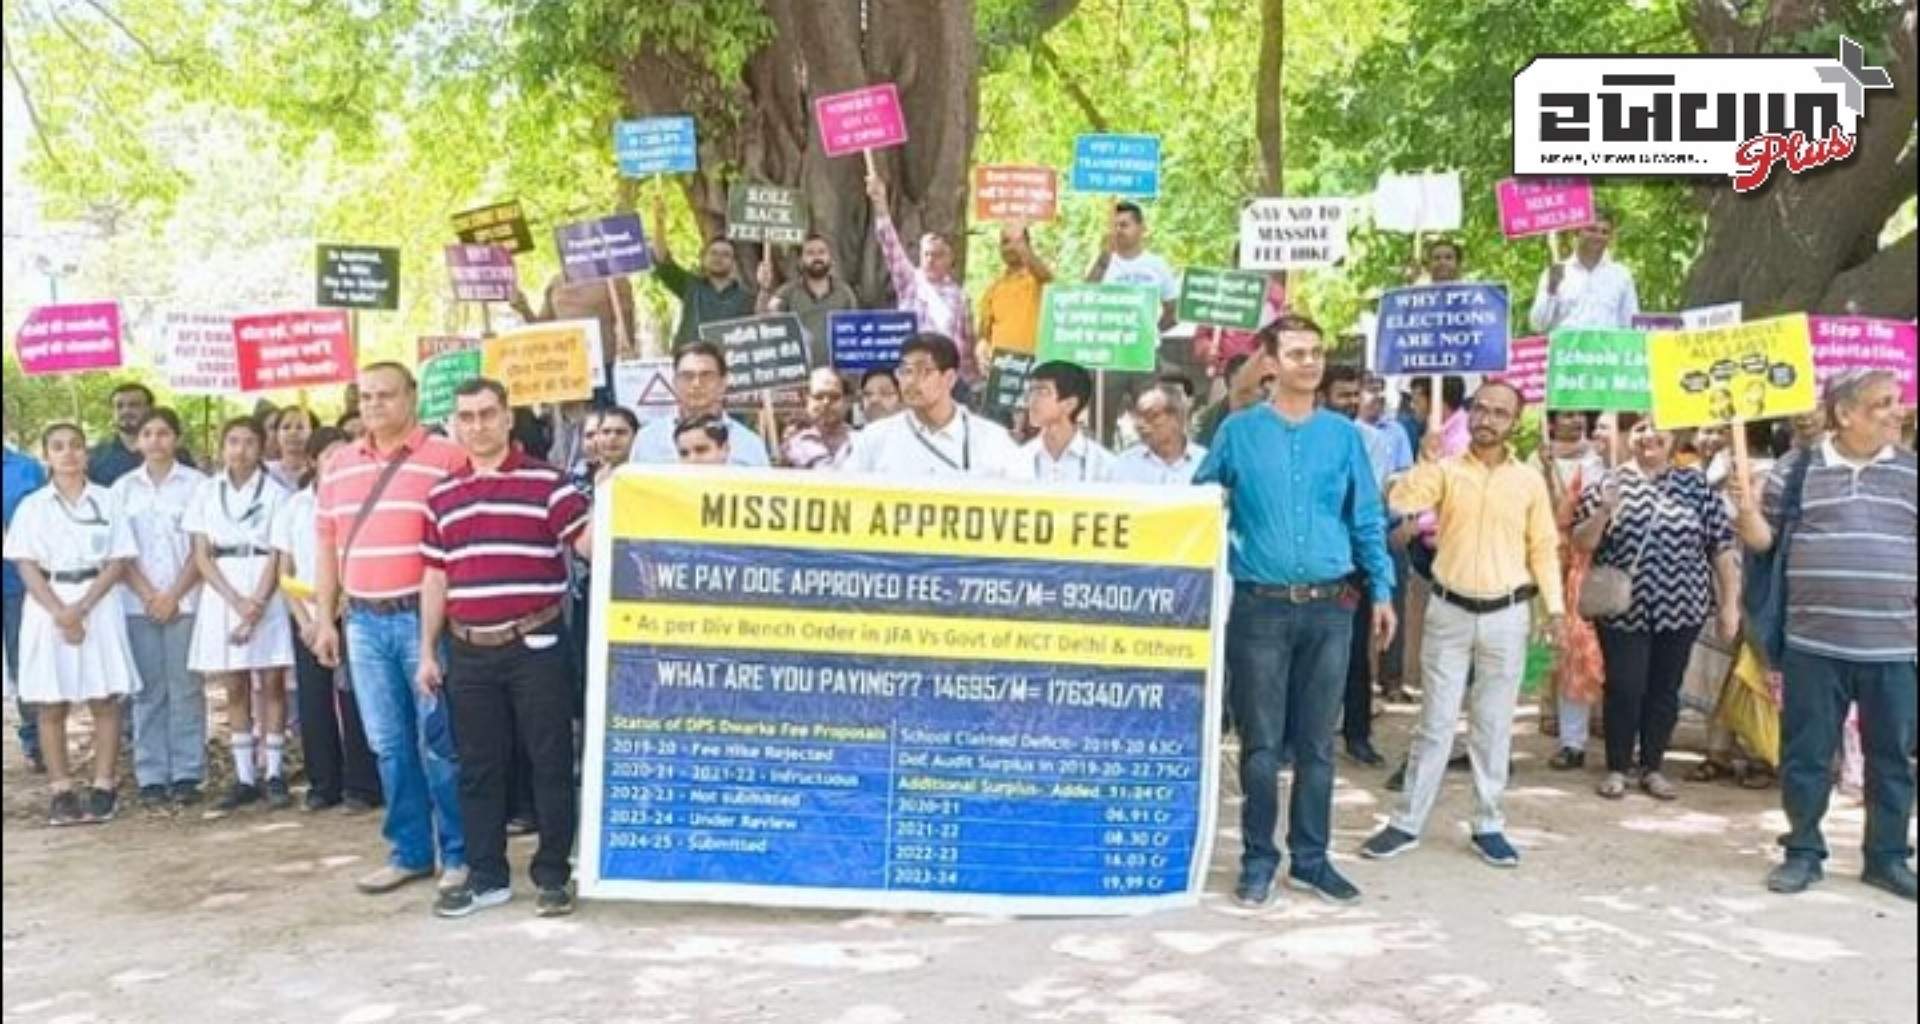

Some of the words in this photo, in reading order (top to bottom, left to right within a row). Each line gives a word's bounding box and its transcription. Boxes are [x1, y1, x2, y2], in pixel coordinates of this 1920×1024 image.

[747, 187, 792, 205] ROLL
[745, 206, 792, 223] BACK
[1250, 206, 1279, 220] SAY
[1288, 206, 1313, 220] NO
[1320, 205, 1340, 220] TO
[728, 223, 761, 240] FEE
[1258, 226, 1329, 241] MASSIVE
[1255, 246, 1282, 261] FEE
[1290, 246, 1328, 261] HIKE
[1394, 292, 1440, 308] WHY
[1446, 289, 1486, 305] PTA
[1385, 309, 1497, 330] ELECTIONS
[1817, 321, 1861, 339] Stop
[1866, 319, 1895, 339] the
[1396, 332, 1435, 348] ARE
[1439, 329, 1484, 346] NOT
[1402, 351, 1457, 369] HELD
[1463, 351, 1474, 367] ?
[1555, 349, 1619, 366] Schools
[1554, 373, 1591, 391] DoE
[701, 492, 851, 535] MISSION
[868, 500, 1054, 546] APPROVED
[1071, 511, 1131, 549] FEE
[657, 564, 689, 591] WE
[695, 565, 737, 593] PAY
[743, 567, 784, 595] DOE
[790, 569, 900, 600] APPROVED
[906, 575, 953, 601] FEE-
[958, 577, 1057, 607] 7785/M=
[1062, 582, 1175, 614] 93400/YR
[637, 614, 659, 633] As
[665, 618, 696, 639] per
[702, 617, 731, 636] Div
[738, 618, 796, 637] Bench
[802, 621, 854, 641] Order
[860, 623, 877, 641] in
[884, 623, 913, 645] JFA
[918, 627, 940, 645] Vs
[944, 628, 985, 648] Govt
[992, 629, 1013, 648] of
[1017, 630, 1054, 651] NCT
[1058, 632, 1108, 653] Delhi
[1114, 637, 1127, 655] &
[1133, 637, 1196, 659] Others
[657, 660, 718, 687] WHAT
[731, 662, 767, 690] ARE
[771, 665, 813, 692] YOU
[819, 668, 921, 698] PAYING??
[1047, 679, 1165, 711] 176340/YR
[610, 715, 661, 732] Status
[667, 717, 682, 732] of
[685, 718, 716, 734] DPS
[720, 720, 775, 737] Dwarka
[781, 722, 809, 737] Fee
[813, 724, 887, 742] Proposals
[900, 727, 950, 745] School
[955, 730, 1018, 748] Claimed
[1082, 735, 1145, 752] 2019-20
[611, 739, 678, 757] 2019-20
[692, 743, 721, 758] Fee
[724, 743, 761, 759] Hike
[764, 745, 835, 764] Rejected
[932, 752, 974, 769] Audit
[978, 755, 1034, 774] Surplus
[610, 764, 675, 780] 2020-21
[692, 766, 757, 783] 2021-22
[769, 770, 860, 788] Infructuous
[690, 789, 718, 804] Not
[722, 790, 802, 808] submitted
[899, 775, 976, 793] Additional
[1051, 781, 1101, 800] Added
[1155, 785, 1175, 801] Cr
[609, 810, 674, 826] 2023-24
[690, 812, 737, 829] Under
[741, 813, 798, 832] Review
[899, 798, 960, 815] 2020-21
[1153, 808, 1171, 824] Cr
[608, 833, 673, 849] 2024-25
[687, 835, 769, 855] Submitted
[896, 822, 959, 838] 2021-22
[1152, 831, 1170, 847] Cr
[895, 845, 959, 862] 2022-23
[1150, 854, 1168, 869] Cr
[894, 867, 959, 885] 2023-24
[1150, 876, 1164, 890] Cr
